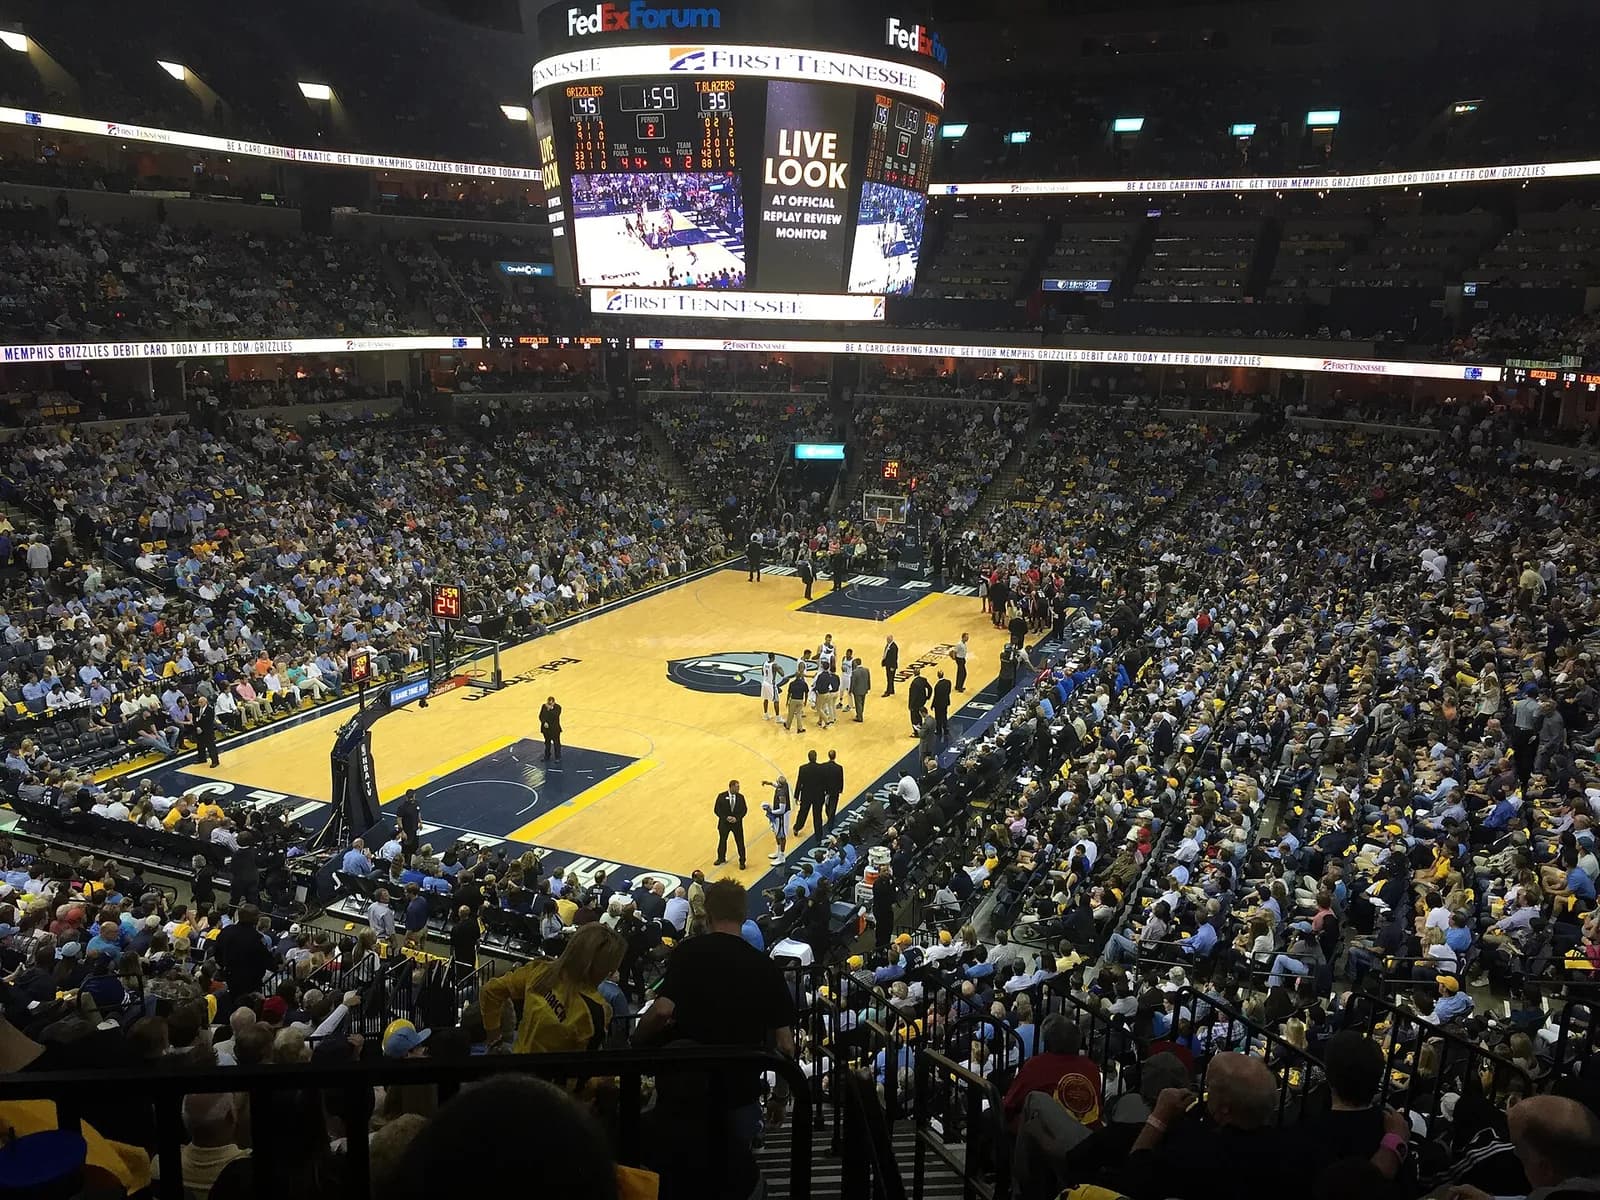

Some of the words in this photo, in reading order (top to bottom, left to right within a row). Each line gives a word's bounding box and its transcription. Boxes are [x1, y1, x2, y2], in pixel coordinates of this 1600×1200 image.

[567, 1, 721, 36] FedExForum
[712, 51, 781, 70] FIRST
[789, 54, 919, 89] TENNESSEE
[567, 86, 604, 97] GRIZZLIES
[642, 87, 675, 109] 1:59
[709, 92, 726, 109] 35
[579, 97, 596, 113] 45
[599, 121, 603, 129] 7
[705, 117, 711, 127] 0
[713, 118, 719, 127] 2
[730, 117, 733, 126] 7
[648, 124, 654, 136] 2
[706, 128, 711, 137] 3
[729, 128, 733, 137] 2
[578, 132, 582, 140] 9
[599, 132, 604, 140] 0
[576, 142, 583, 150] 11
[586, 142, 591, 150] 0
[597, 141, 605, 149] 11
[703, 139, 711, 147] 12
[715, 139, 720, 147] 0
[726, 139, 734, 147] 11
[779, 129, 837, 159] LIVE
[575, 151, 584, 160] 33
[601, 151, 605, 159] 7
[701, 150, 711, 158] 42
[715, 149, 720, 158] 0
[729, 149, 734, 158] 6
[226, 141, 235, 150] BE
[244, 143, 261, 153] CARD
[337, 154, 352, 163] GET
[355, 156, 375, 165] YOUR
[378, 157, 412, 168] MEMPHIS
[416, 160, 452, 172] GRIZZLIES
[455, 164, 475, 174] DEBIT
[478, 167, 496, 175] CARD
[499, 168, 520, 177] TODAY
[523, 170, 530, 178] AT
[621, 158, 629, 168] 4
[635, 158, 642, 167] 4
[664, 157, 671, 167] 4
[685, 157, 692, 167] 2
[701, 159, 712, 168] 88
[730, 159, 735, 167] 4
[575, 161, 585, 170] 50
[601, 161, 606, 170] 0
[542, 161, 561, 190] LOOK
[765, 158, 848, 189] LOOK
[1139, 182, 1144, 190] A
[1147, 182, 1166, 190] CARD
[1170, 181, 1207, 189] CARRYING
[1250, 180, 1263, 188] GET
[1268, 180, 1287, 188] YOUR
[1291, 179, 1328, 187] MEMPHIS
[1332, 177, 1370, 187] GRIZZLIES
[1373, 176, 1394, 185] DEBIT
[1398, 174, 1417, 183] CARD
[1421, 173, 1445, 182] TODAY
[1449, 172, 1458, 180] AT
[772, 195, 786, 205] AT
[789, 196, 835, 208] OFFICIAL
[764, 211, 802, 222] REPLAY
[804, 213, 842, 224] REVIEW
[776, 228, 827, 239] MONITOR
[600, 270, 640, 281] Forum
[624, 293, 667, 310] FIRST
[677, 295, 802, 313] TENNESSEE
[4, 347, 54, 361] MEMPHIS
[58, 346, 109, 358] GRIZZLIES
[113, 345, 140, 356] DEBIT
[144, 344, 167, 355] CARD
[171, 343, 198, 355] TODAY
[202, 343, 211, 354] AT
[846, 344, 854, 352] BE
[858, 344, 862, 352] A
[865, 345, 884, 353] CARD
[887, 345, 922, 354] CARRYING
[925, 346, 956, 355] FANATIC
[961, 347, 974, 355] GET
[978, 348, 996, 356] YOUR
[1000, 349, 1035, 358] MEMPHIS
[1038, 350, 1078, 360] GRIZZLIES
[1081, 352, 1103, 360] DEBIT
[1107, 353, 1128, 361] CARD
[1132, 354, 1157, 362] TODAY
[1161, 354, 1171, 362] AT
[1348, 363, 1387, 372] TENNESSEE
[885, 468, 896, 477] 24
[442, 588, 457, 597] 1:59
[437, 597, 455, 614] 24
[355, 666, 365, 677] 24
[396, 689, 407, 700] GAME
[362, 756, 370, 780] NBA
[366, 781, 372, 796] TV
